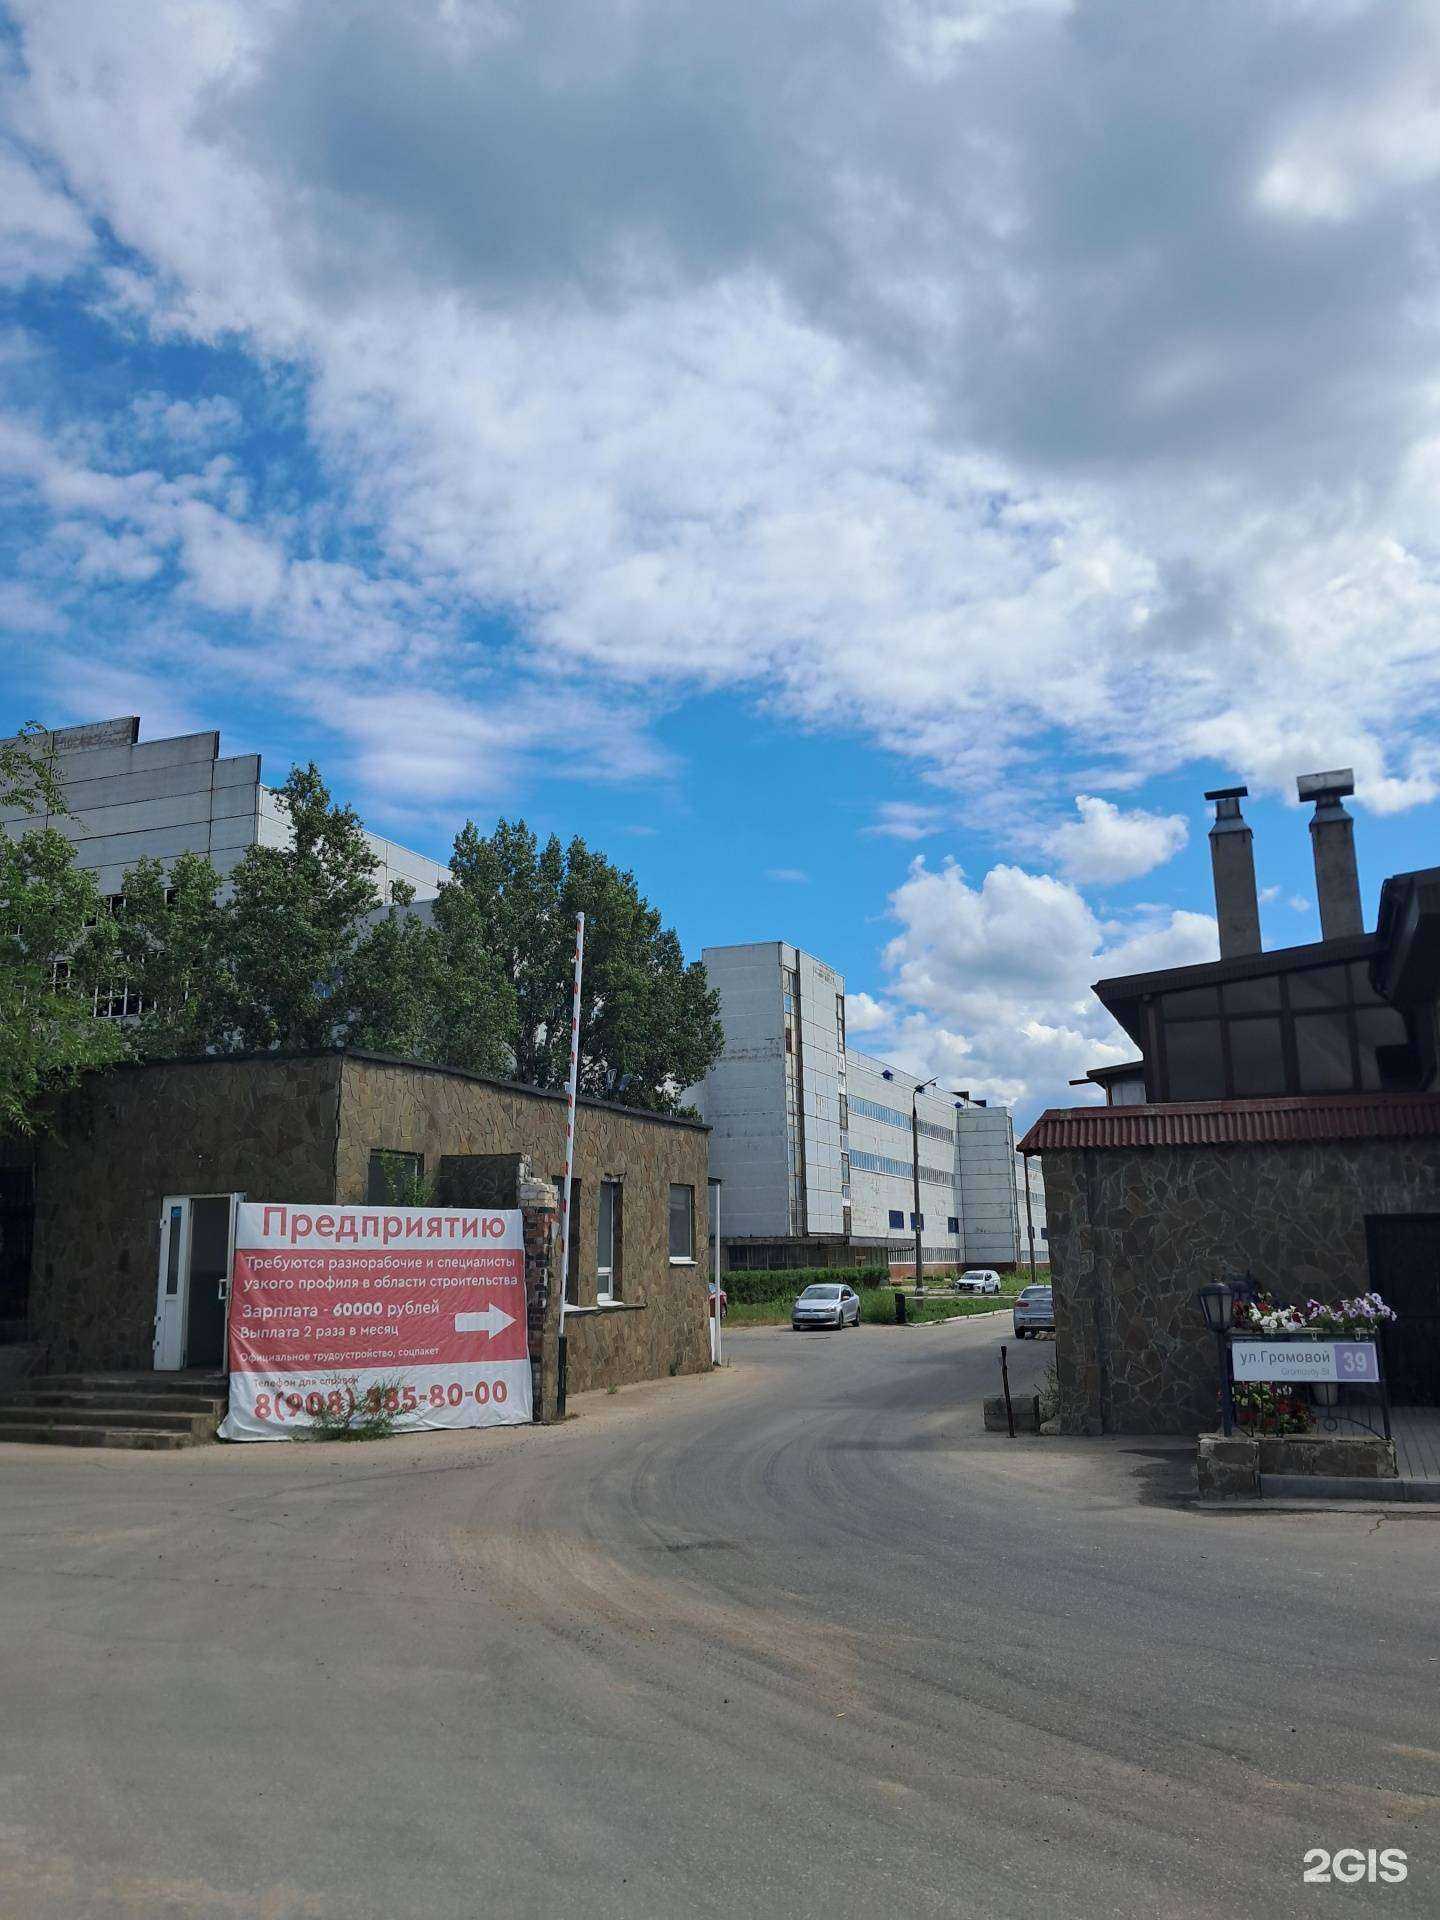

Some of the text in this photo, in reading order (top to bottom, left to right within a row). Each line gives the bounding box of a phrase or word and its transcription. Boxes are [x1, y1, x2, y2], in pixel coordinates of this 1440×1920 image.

[262, 1206, 506, 1245] Предприятию
[246, 1255, 515, 1271] Требуются разнорабочие и специалисты
[243, 1274, 518, 1292] узкого профиля в области строительства
[242, 1304, 318, 1320] Зарплата
[333, 1302, 383, 1316] 60000
[387, 1299, 440, 1316] рублей
[240, 1325, 399, 1340] Выплата 2 раза в месяц
[239, 1346, 439, 1362] Официальное трудоустройство, соцпакет
[1343, 1351, 1368, 1373] 39
